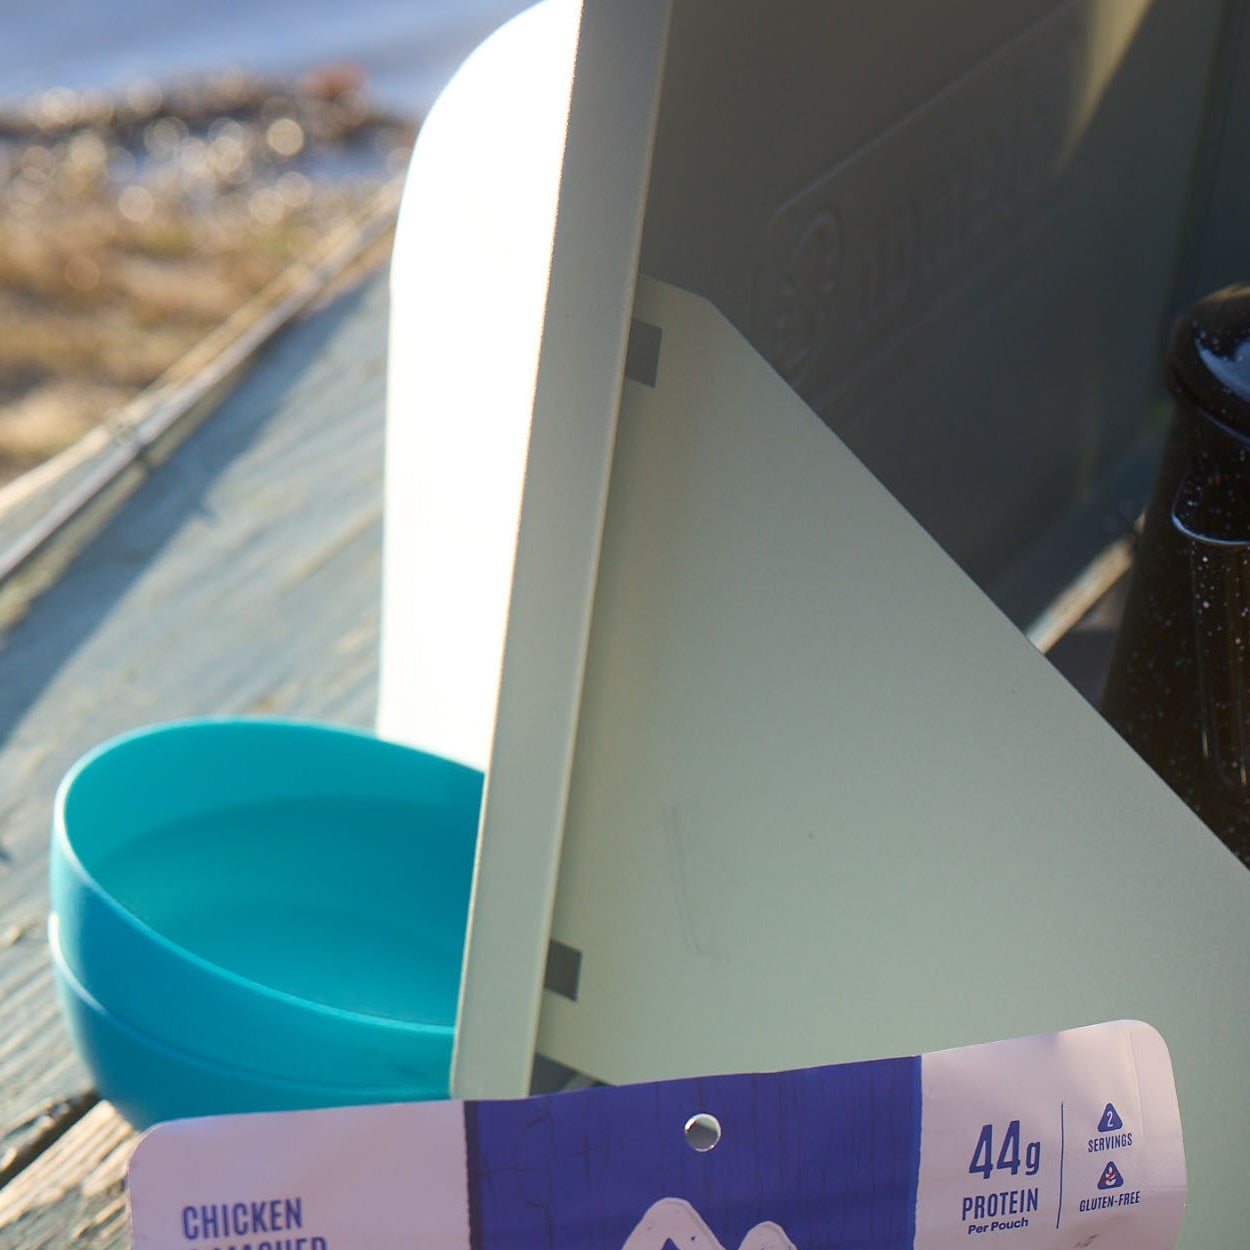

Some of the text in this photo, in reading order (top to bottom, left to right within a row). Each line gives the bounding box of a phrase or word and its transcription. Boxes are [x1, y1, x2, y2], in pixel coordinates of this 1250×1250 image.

[1106, 1111, 1114, 1127] 2
[969, 1119, 1041, 1179] 44g
[1088, 1133, 1133, 1153] SERVINGS
[962, 1188, 1039, 1221] PROTEIN
[1079, 1191, 1141, 1212] GLUTEN-FREE
[183, 1197, 302, 1240] CHICKEN
[968, 1217, 1029, 1235] Per Pouch
